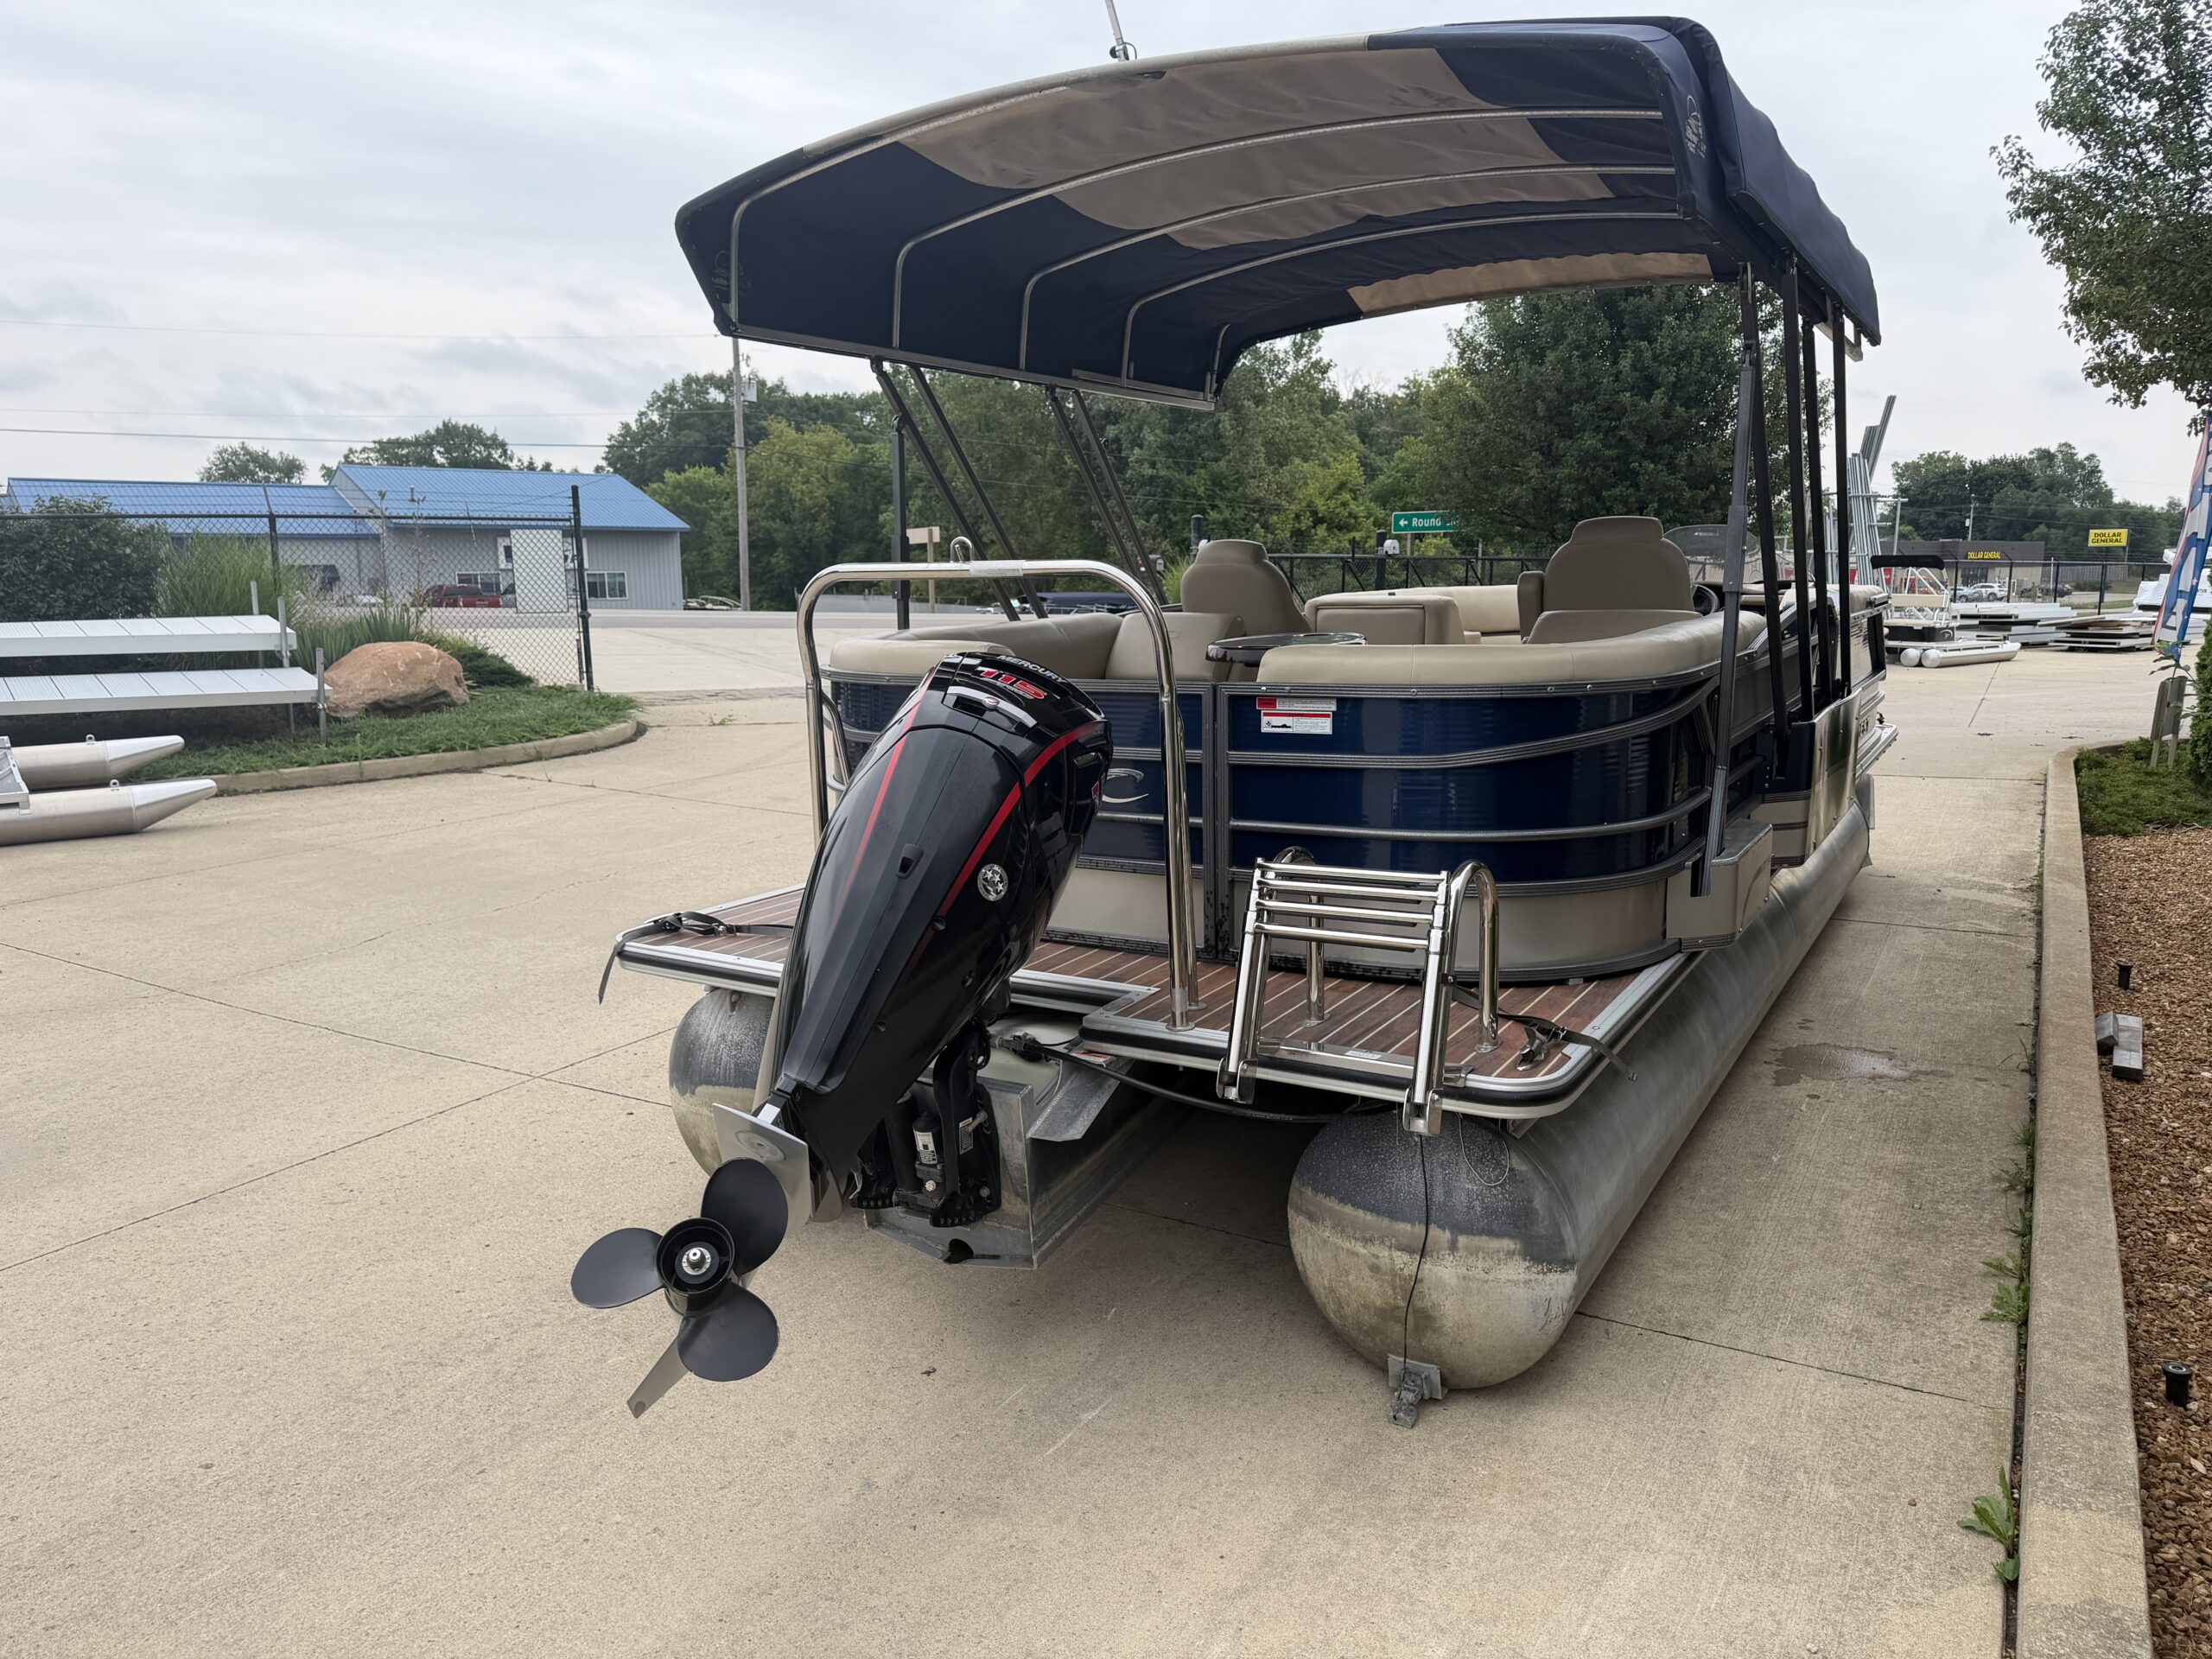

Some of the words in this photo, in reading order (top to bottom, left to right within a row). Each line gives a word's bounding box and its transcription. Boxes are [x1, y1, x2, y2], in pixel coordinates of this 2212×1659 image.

[1412, 517, 1441, 527] Round
[996, 654, 1069, 683] MERCURY
[980, 670, 1048, 700] 115
